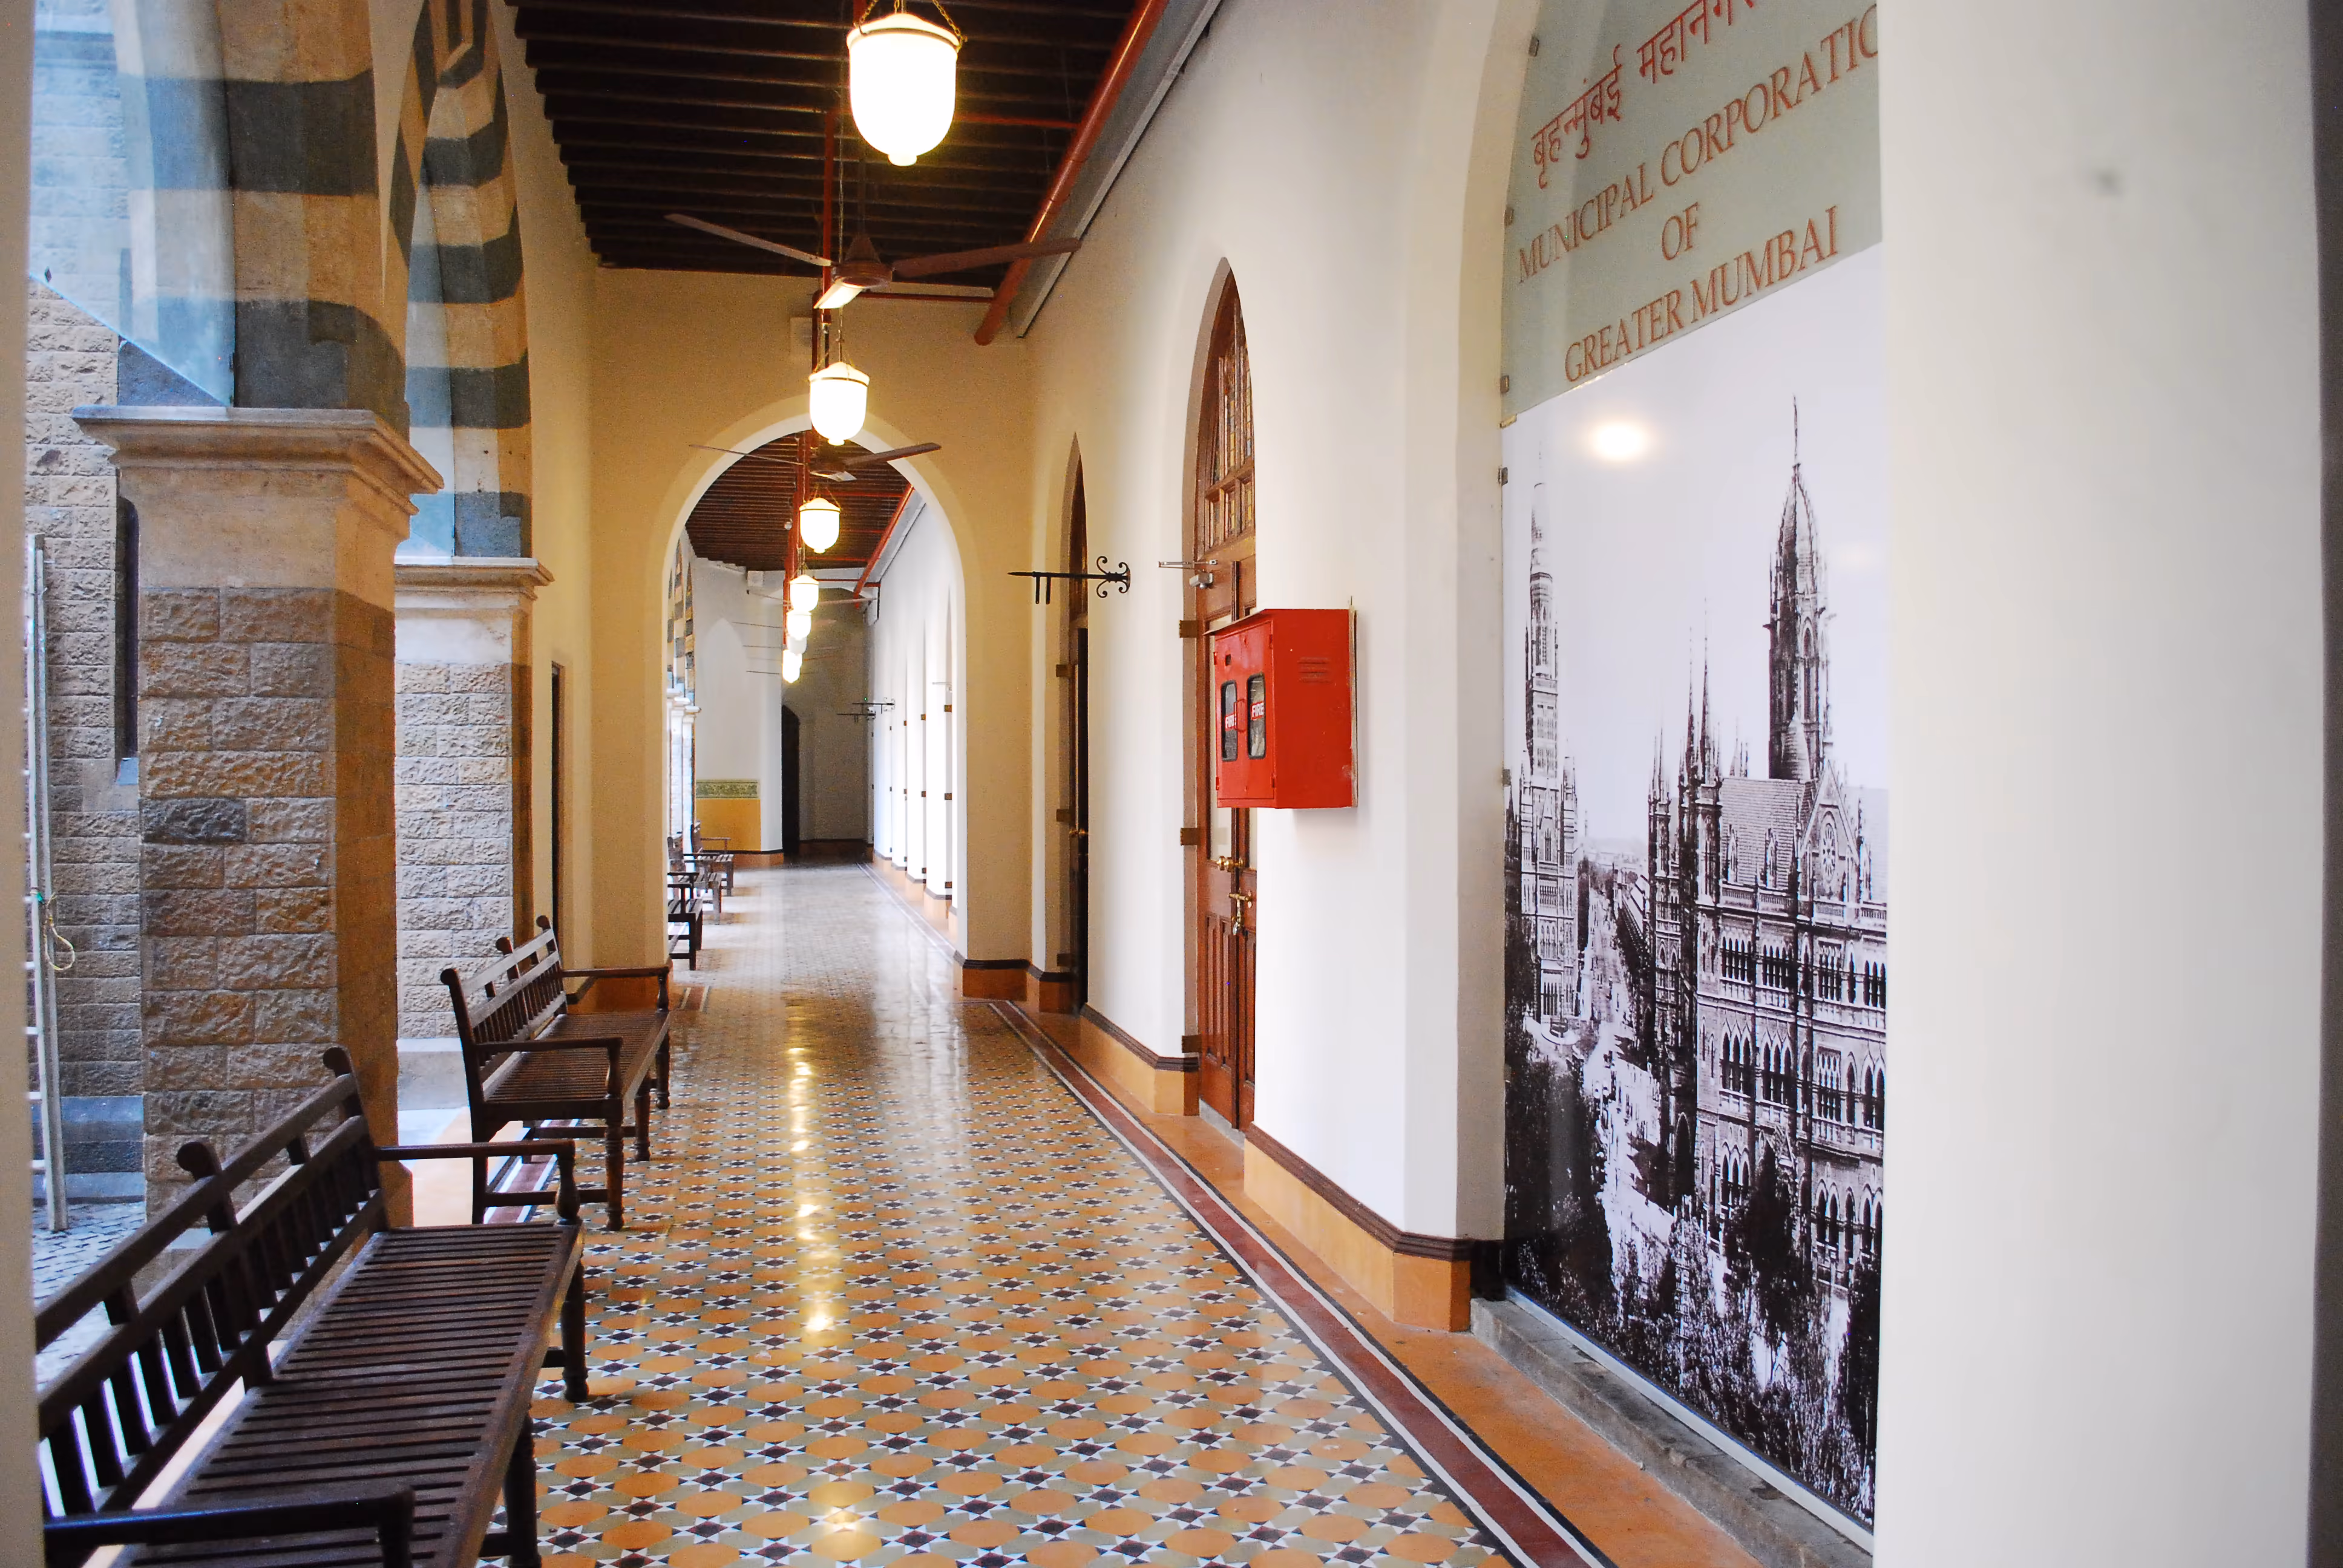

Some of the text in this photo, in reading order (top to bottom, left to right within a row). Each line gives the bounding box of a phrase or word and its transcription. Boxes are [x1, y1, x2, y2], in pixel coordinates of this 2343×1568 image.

[1518, 163, 1654, 284] MUNICIPAL
[1660, 203, 1701, 261] OF
[1565, 206, 1838, 382] GREATER MUMBAI
[1252, 702, 1264, 717] FIRE
